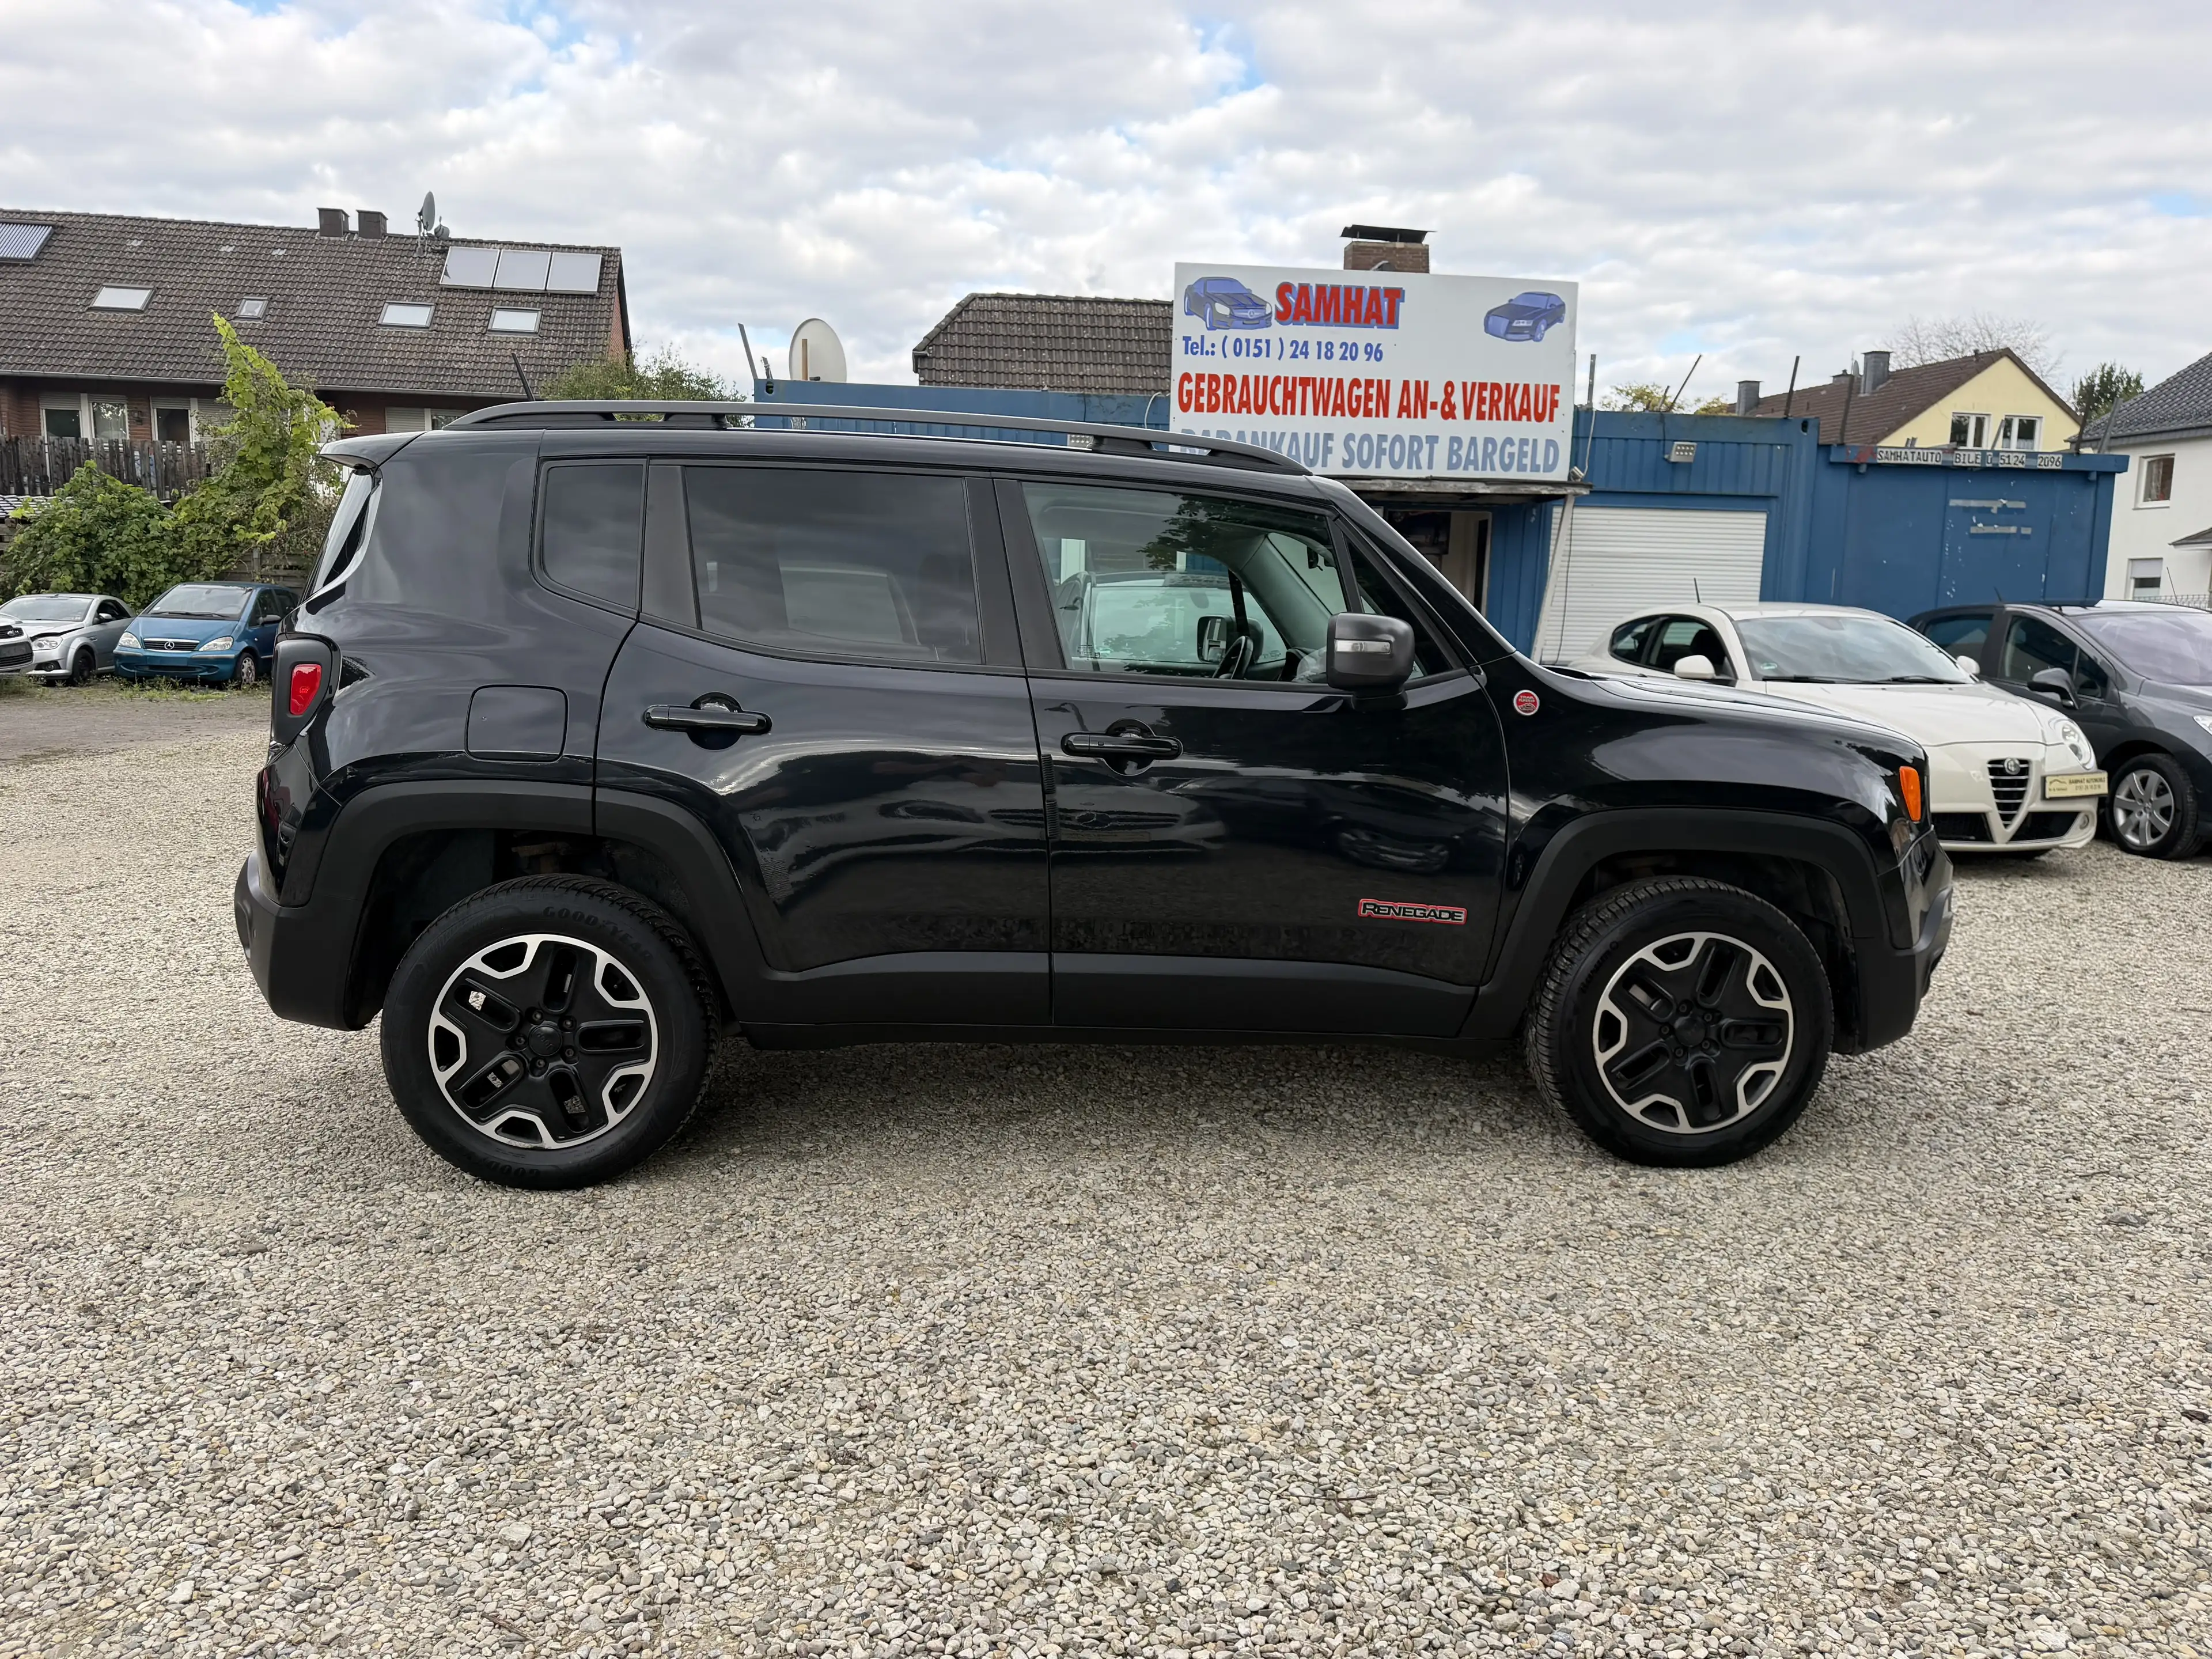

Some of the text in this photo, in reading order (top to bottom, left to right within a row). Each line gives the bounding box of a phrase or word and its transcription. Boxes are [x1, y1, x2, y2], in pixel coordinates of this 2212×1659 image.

[1275, 282, 1404, 328] SAMHAT
[1182, 335, 1215, 356] Tel.:
[1233, 338, 1271, 358] 0151
[1289, 339, 1309, 359] 24
[1317, 341, 1334, 360] 18
[1339, 342, 1359, 361] 20
[1364, 343, 1383, 362] 96
[1178, 372, 1391, 418] GEBRAUCHTWAGEN
[1461, 381, 1560, 422] VERKAUF
[1342, 433, 1439, 469] SOFORT
[1447, 435, 1560, 473] BARGELD
[2038, 455, 2061, 467] 2096
[1359, 900, 1465, 923] RENEGADE
